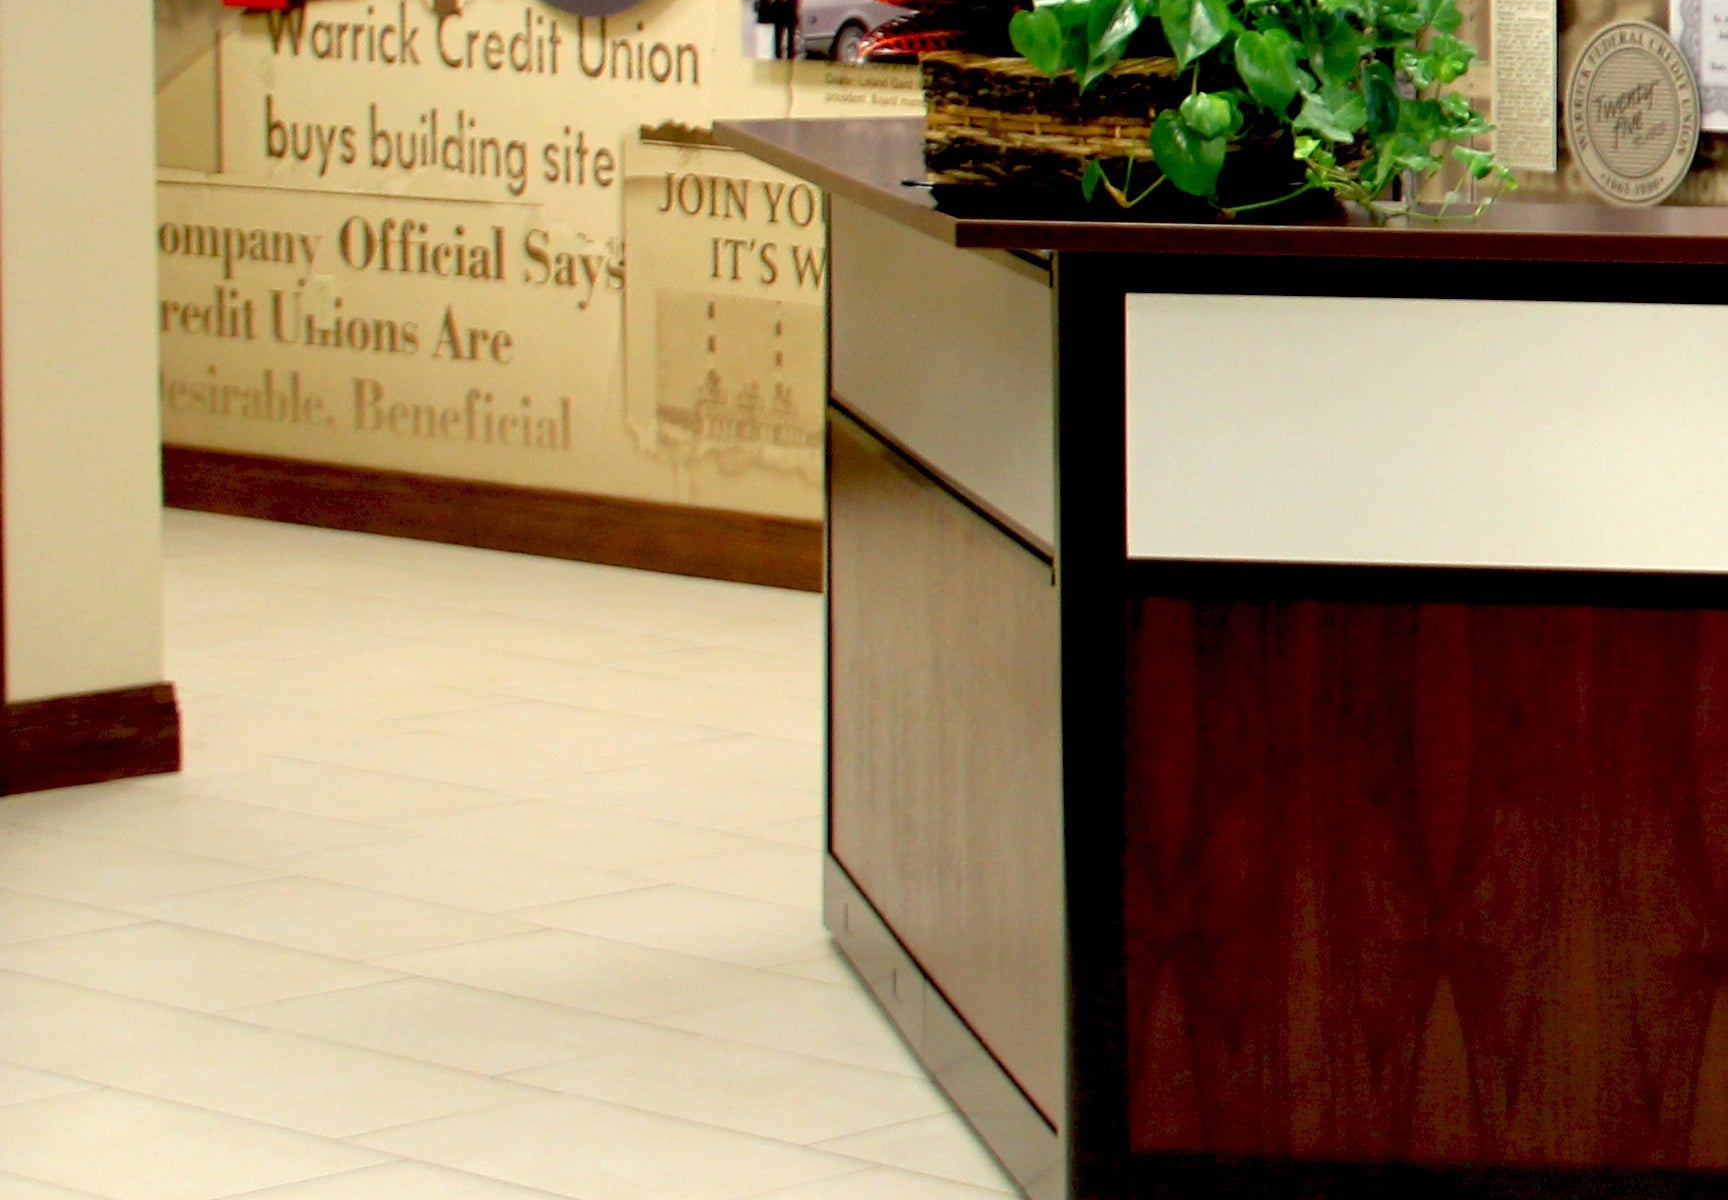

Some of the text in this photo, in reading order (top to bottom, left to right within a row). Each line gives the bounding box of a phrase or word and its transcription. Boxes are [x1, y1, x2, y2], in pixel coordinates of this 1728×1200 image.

[268, 1, 701, 86] Warrick Credit Union
[266, 94, 616, 196] buys building site
[658, 171, 752, 221] JOIN
[158, 215, 626, 310] ompany Official Says
[711, 237, 779, 285] IT'S
[158, 285, 257, 341] redit
[432, 304, 515, 365] Are
[160, 366, 574, 452] esirable, Beneficial
